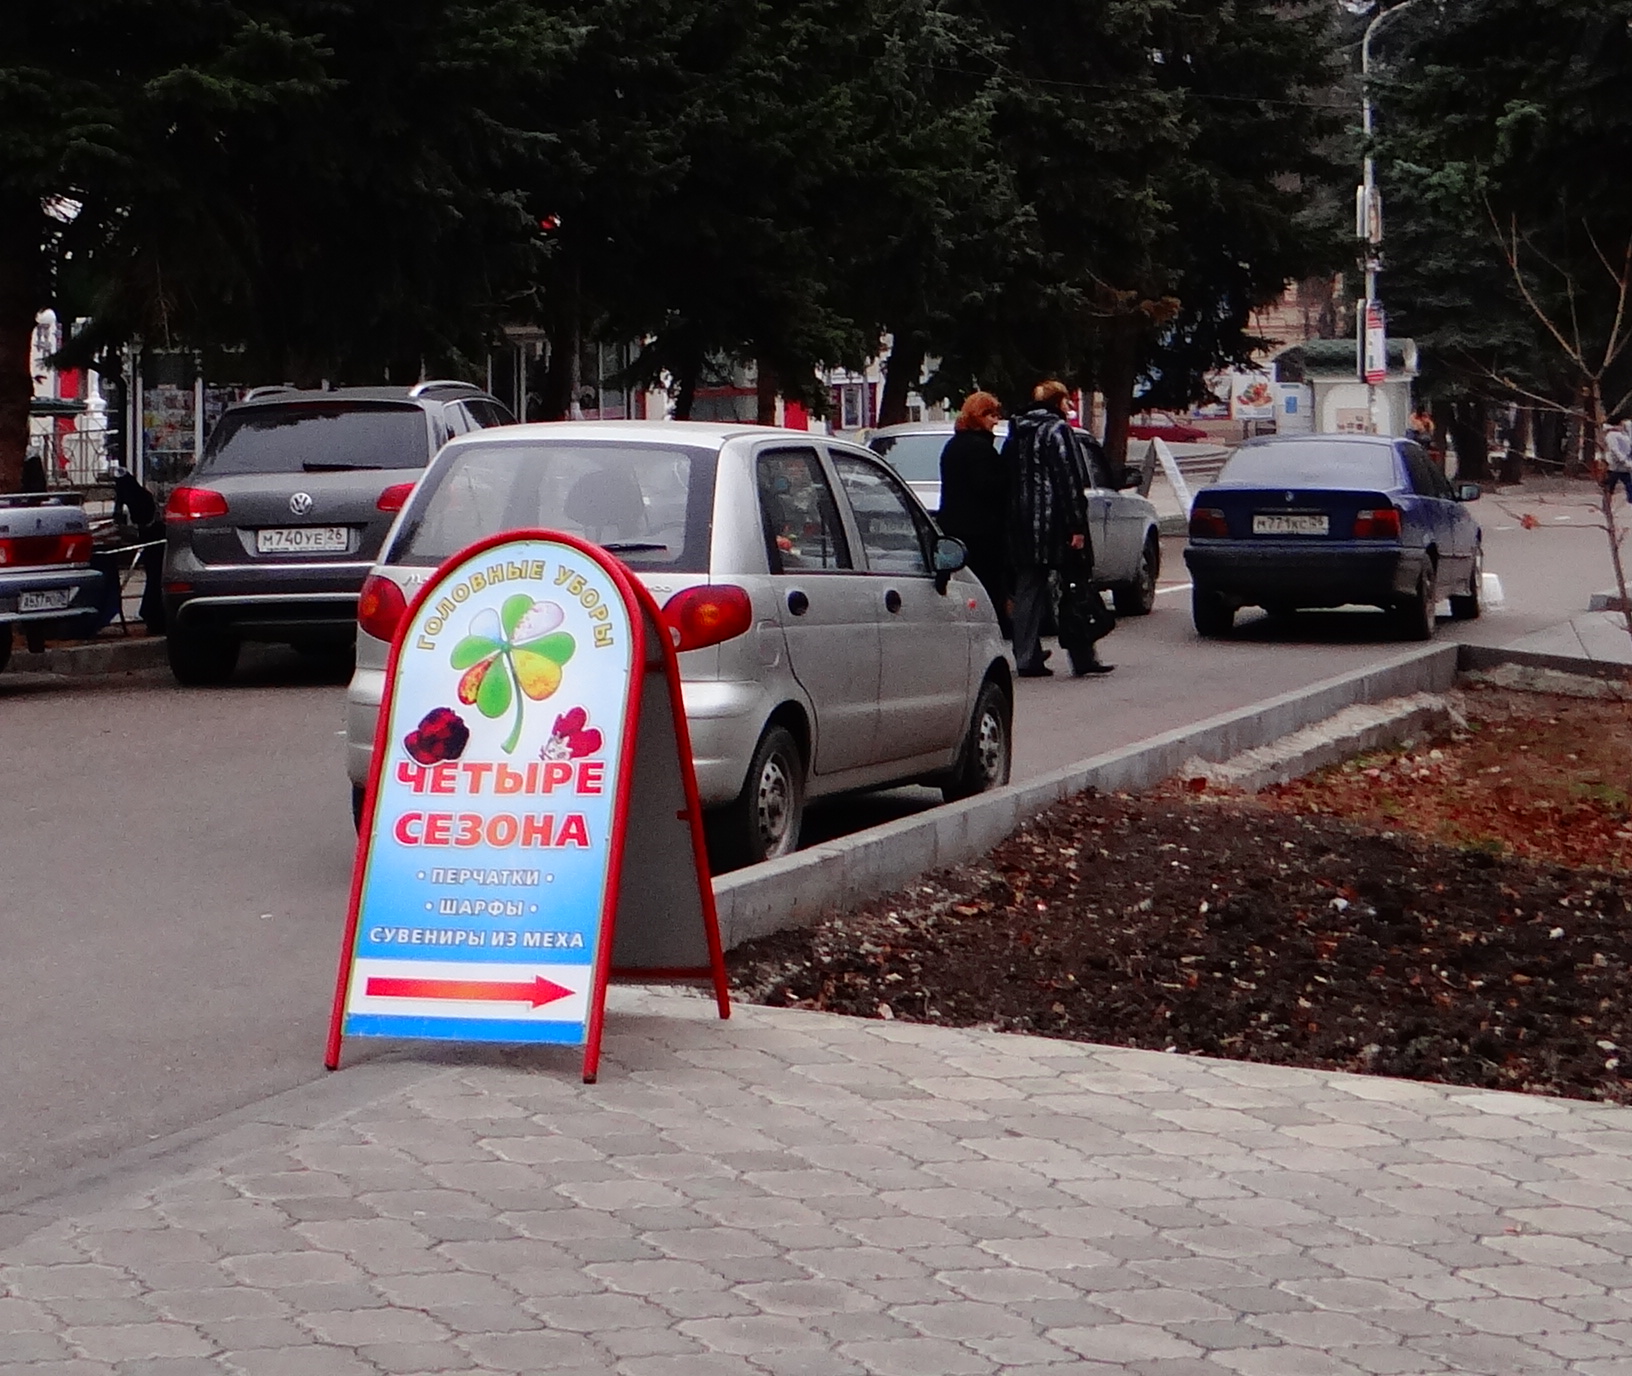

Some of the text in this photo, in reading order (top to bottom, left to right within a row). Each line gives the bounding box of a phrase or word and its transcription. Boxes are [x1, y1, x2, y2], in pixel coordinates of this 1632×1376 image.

[263, 529, 343, 546] М740УЕ 26
[417, 560, 614, 650] ГОЛОВНЫЕ УБОРЫ
[395, 761, 605, 796] ЧЕТЫРЕ
[394, 811, 591, 848] СЕЗОНА
[431, 868, 540, 885] ПЕРЧАТКИ
[439, 899, 524, 916] ШАРФЫ
[370, 927, 585, 949] СУВЕНИРЫ ИЗ МЕХА
